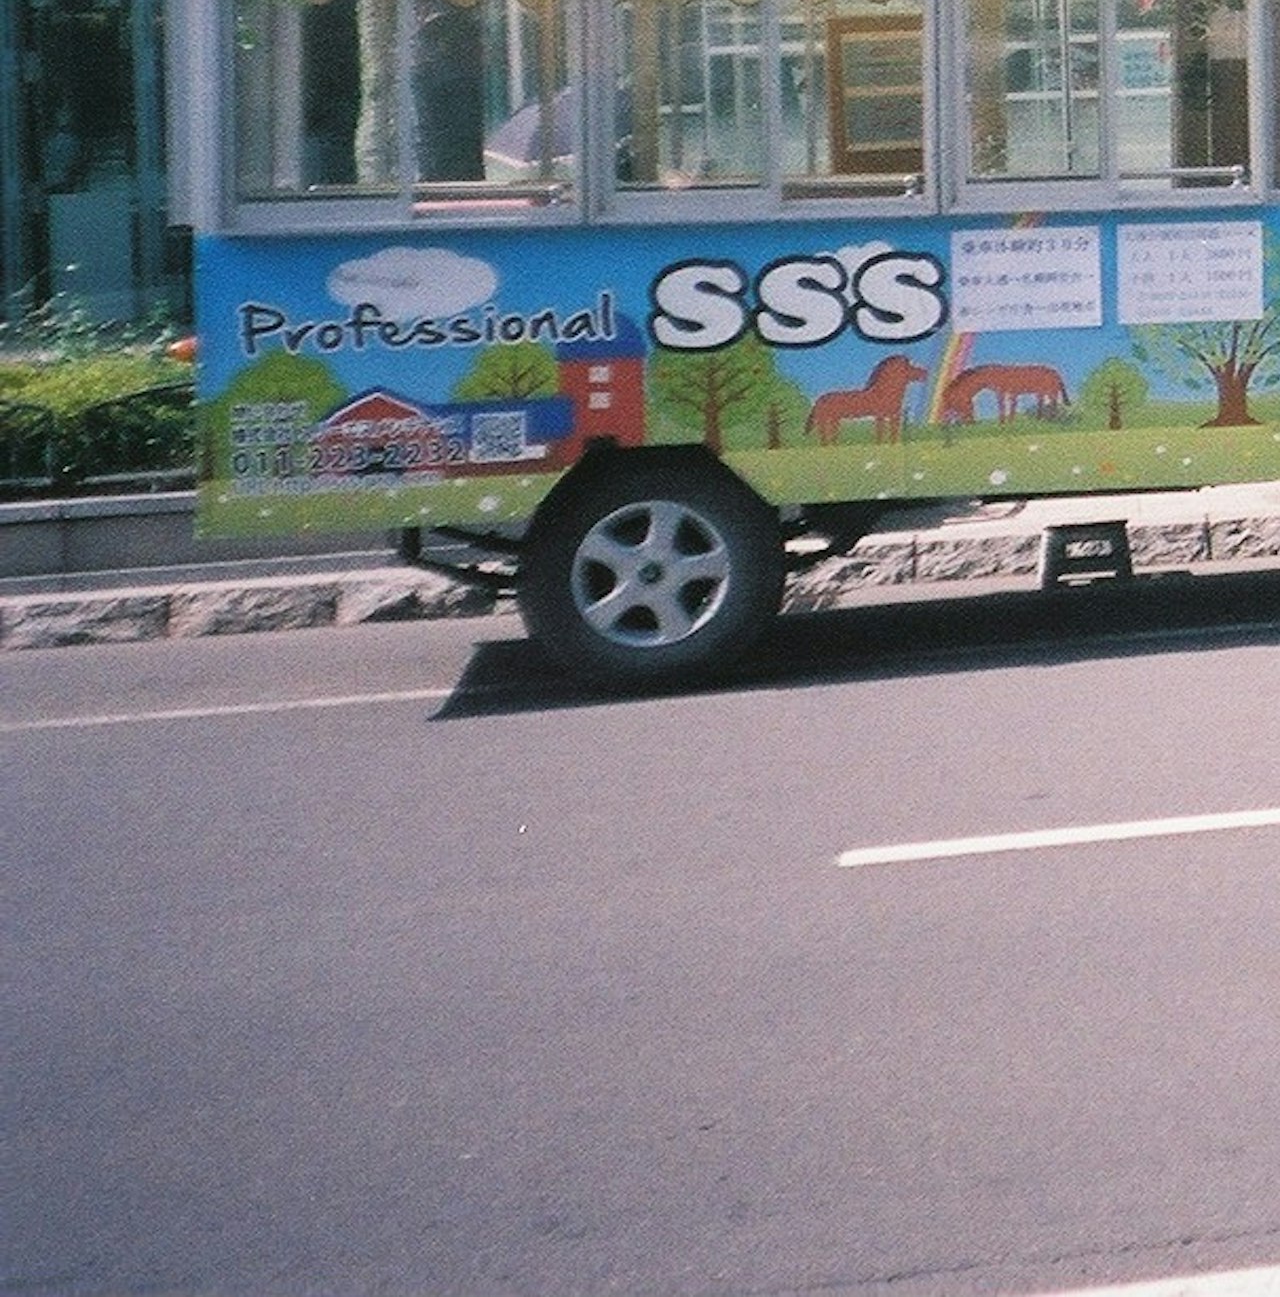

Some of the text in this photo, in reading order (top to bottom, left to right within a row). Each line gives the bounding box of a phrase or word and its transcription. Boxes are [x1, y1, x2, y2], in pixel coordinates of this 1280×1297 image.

[239, 252, 947, 357] Professional SSS
[233, 440, 467, 476] 011-223-2232
